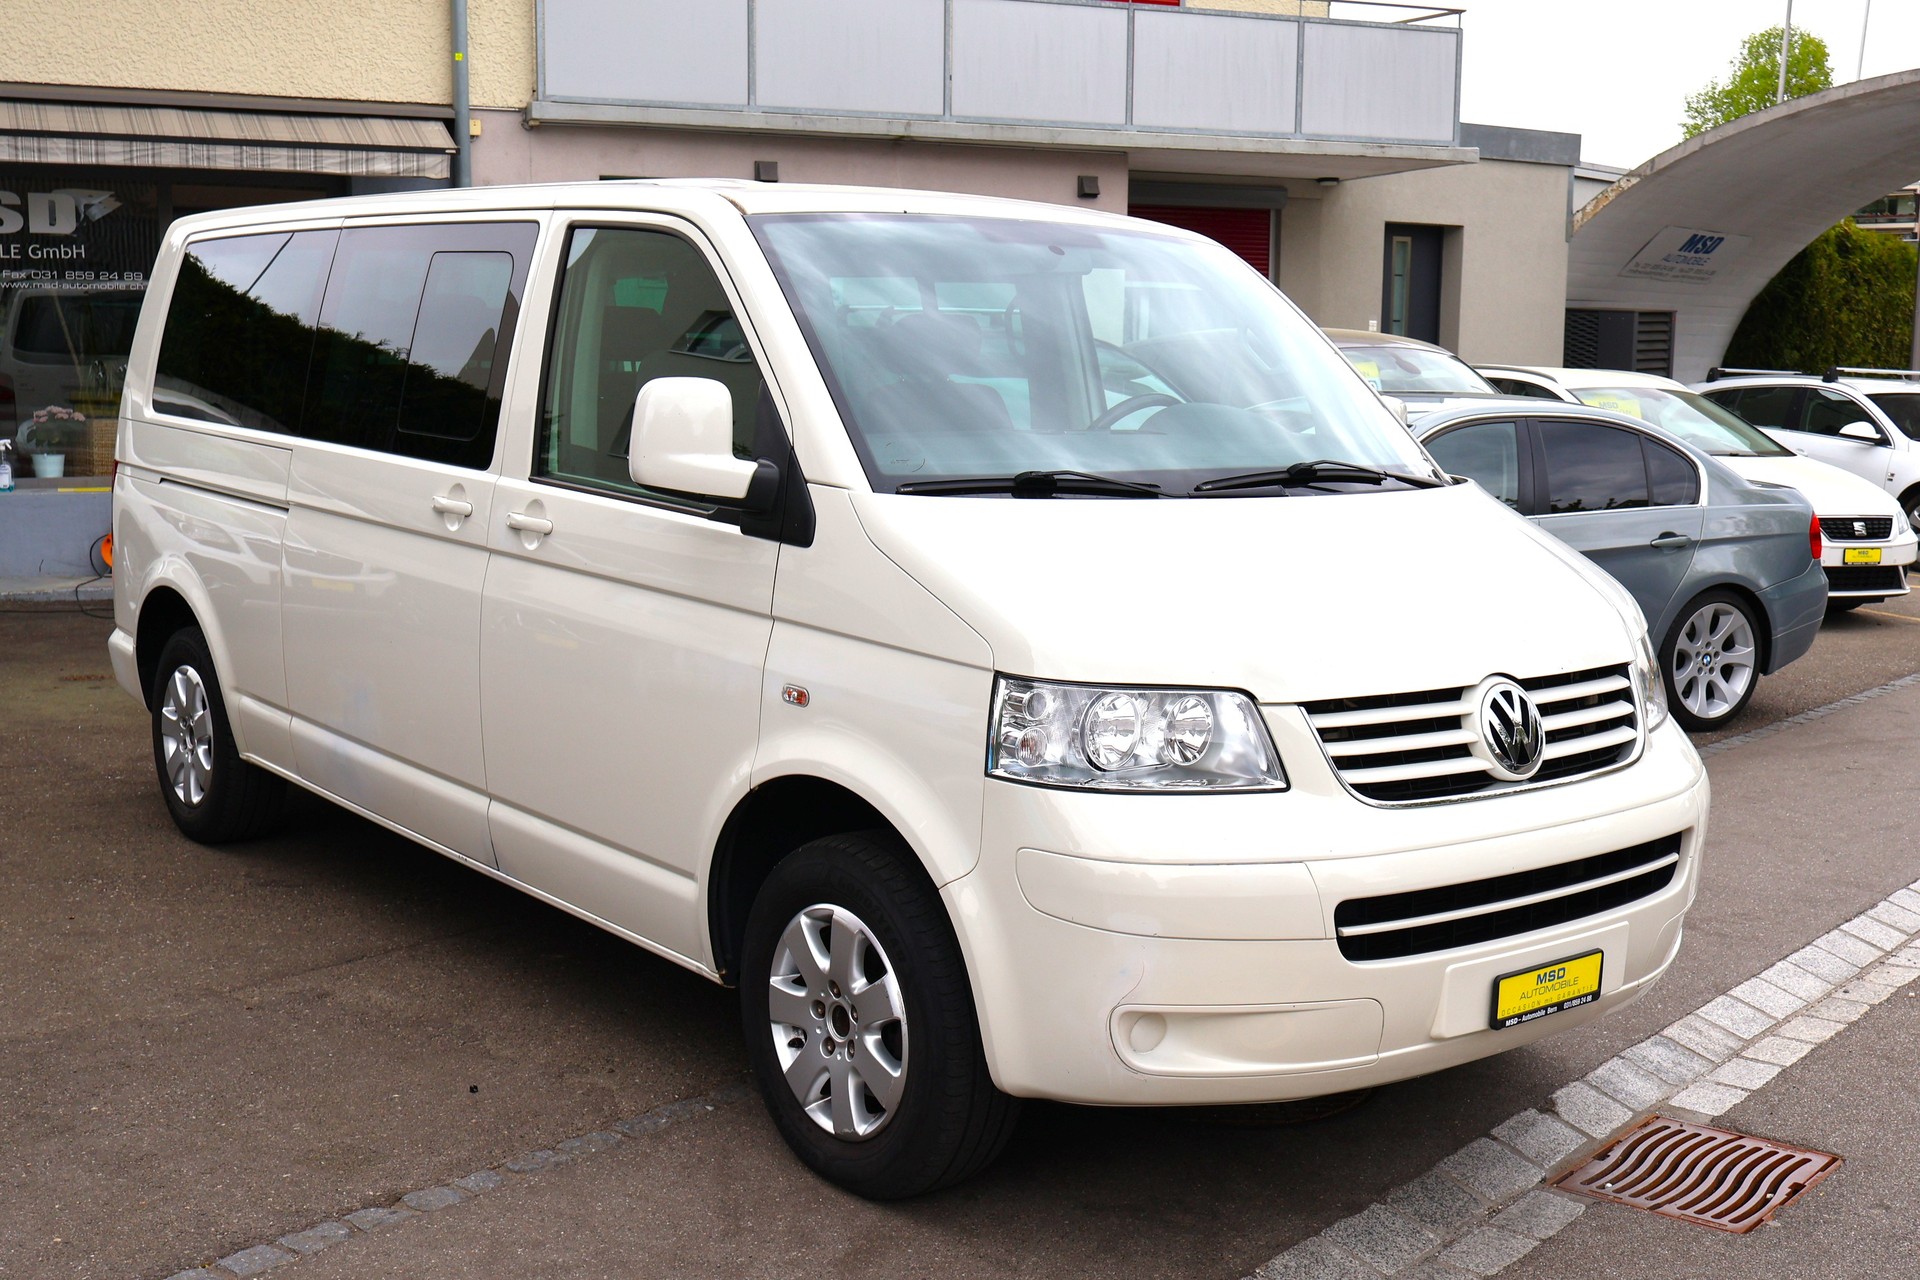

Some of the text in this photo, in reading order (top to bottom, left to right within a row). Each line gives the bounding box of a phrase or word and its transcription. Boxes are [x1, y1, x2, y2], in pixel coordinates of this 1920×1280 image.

[28, 244, 86, 259] GmbH
[1677, 233, 1725, 254] MSD
[2, 269, 143, 281] Fax 031 859 24 89
[1536, 967, 1566, 986] MSD
[1519, 976, 1579, 1000] AUTOMOBILE
[1501, 999, 1541, 1016] OCCASION
[1557, 984, 1594, 1000] GARANTIE
[1505, 1017, 1518, 1027] MSD
